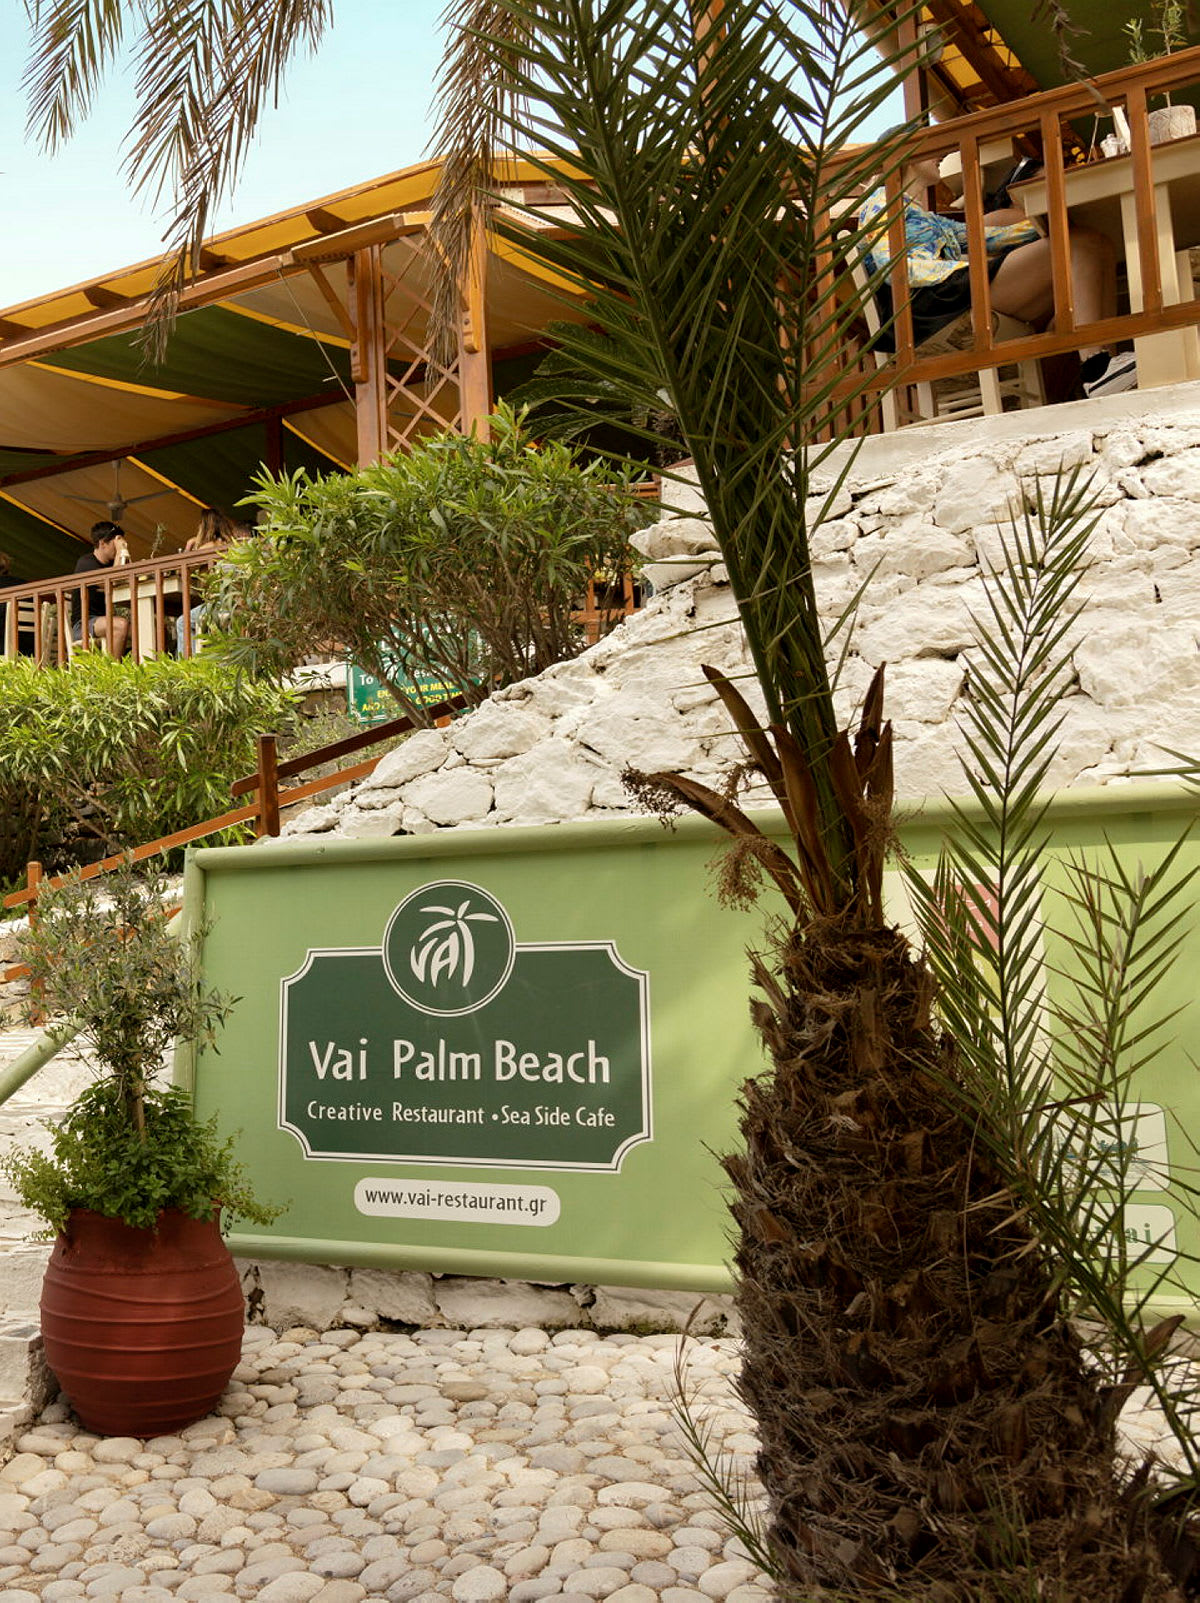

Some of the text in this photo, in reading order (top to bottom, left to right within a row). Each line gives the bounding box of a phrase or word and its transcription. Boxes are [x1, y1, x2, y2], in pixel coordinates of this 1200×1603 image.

[308, 1037, 611, 1084] Vai Palm Beach
[307, 1100, 383, 1121] Creative
[392, 1101, 484, 1124] Restaurant
[535, 1105, 571, 1127] Side
[576, 1106, 616, 1128] Cafe
[364, 1188, 548, 1217] www.vai-restaurant.gr
